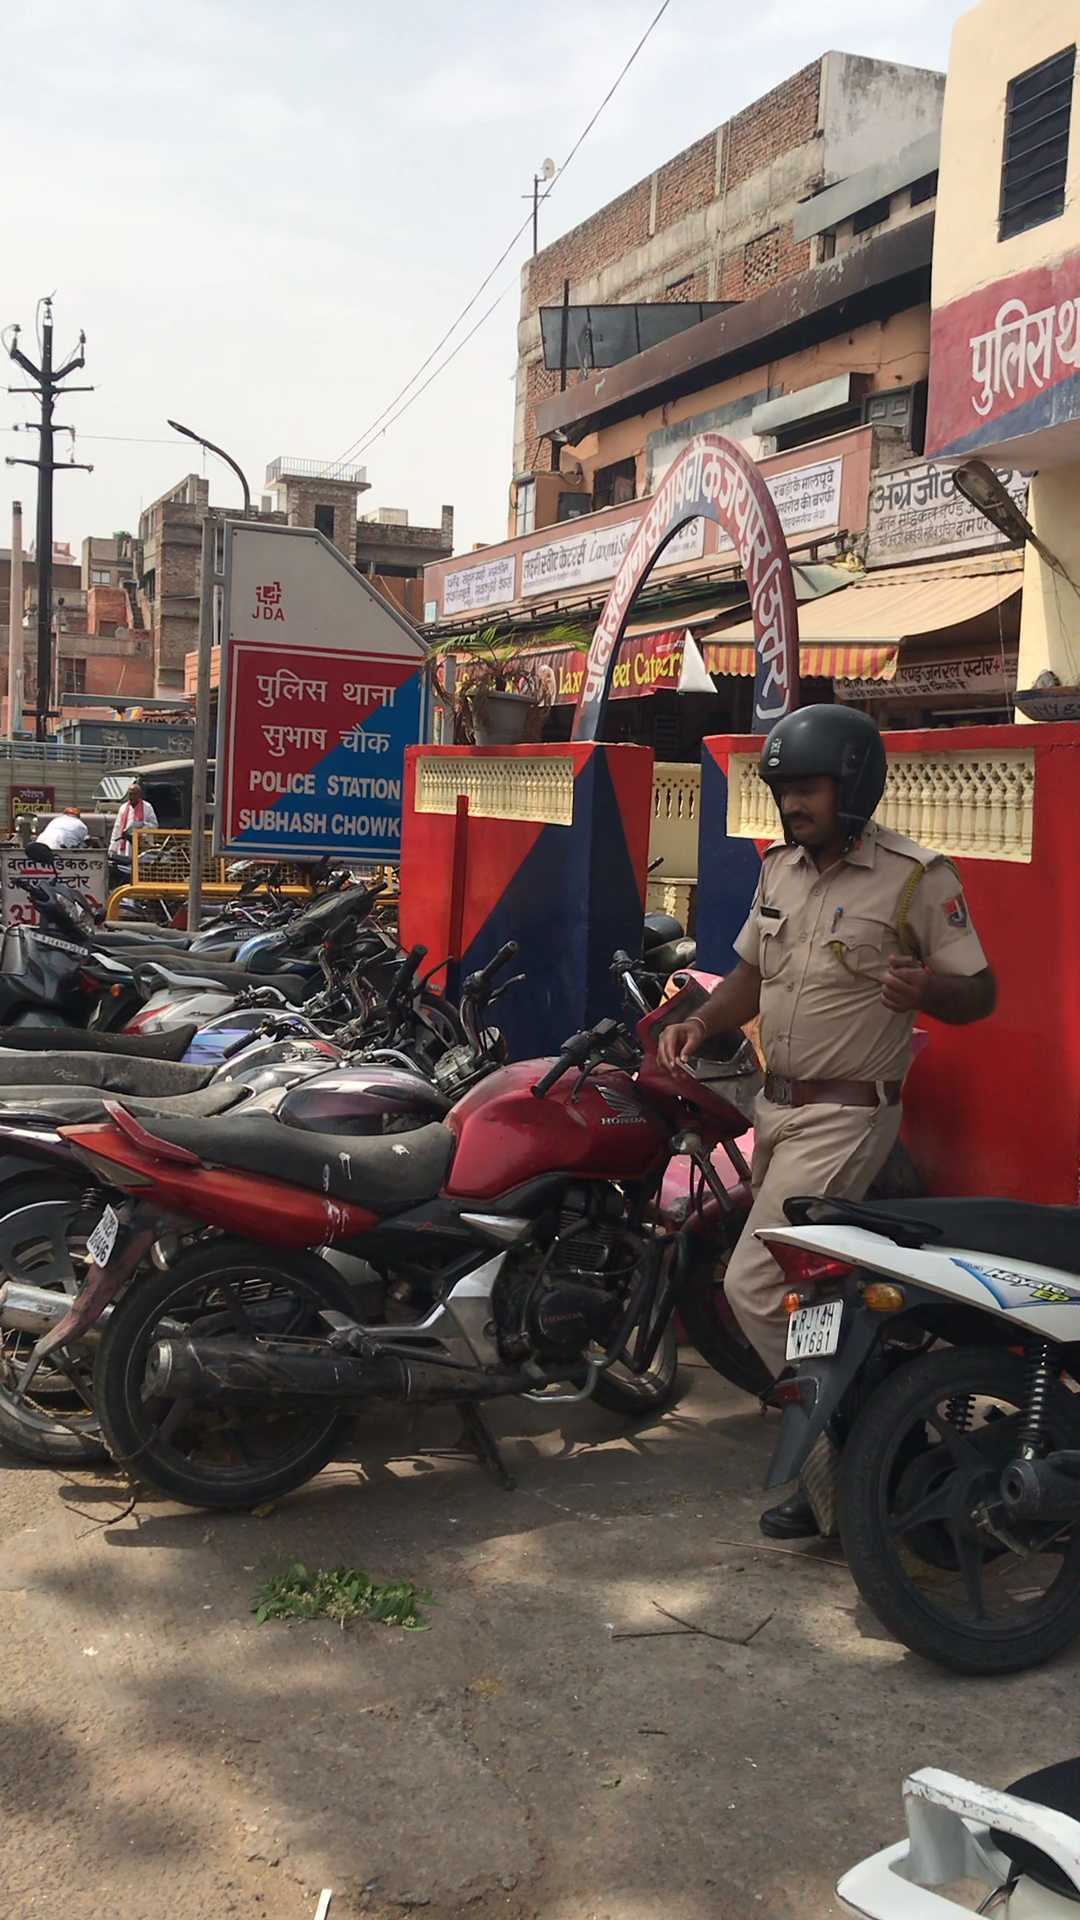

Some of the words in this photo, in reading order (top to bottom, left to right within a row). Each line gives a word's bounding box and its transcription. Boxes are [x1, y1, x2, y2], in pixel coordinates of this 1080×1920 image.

[969, 298, 1056, 416] पुलिस
[252, 606, 285, 622] JDA
[580, 603, 621, 707] पुलिस
[963, 655, 995, 679] स्टोर
[256, 668, 327, 707] पुलिस
[343, 681, 396, 708] थाना
[558, 666, 584, 694] Lax
[612, 657, 631, 688] eet
[261, 724, 327, 758] सुभाष
[339, 722, 391, 754] चौक
[250, 769, 316, 796] POLICE
[327, 776, 400, 799] STATION
[239, 807, 327, 835] SUBHASH
[331, 813, 400, 838] CHOWK
[600, 1117, 647, 1125] HONDA
[983, 1268, 1066, 1294] Hayate
[1030, 1288, 1071, 1302] EP
